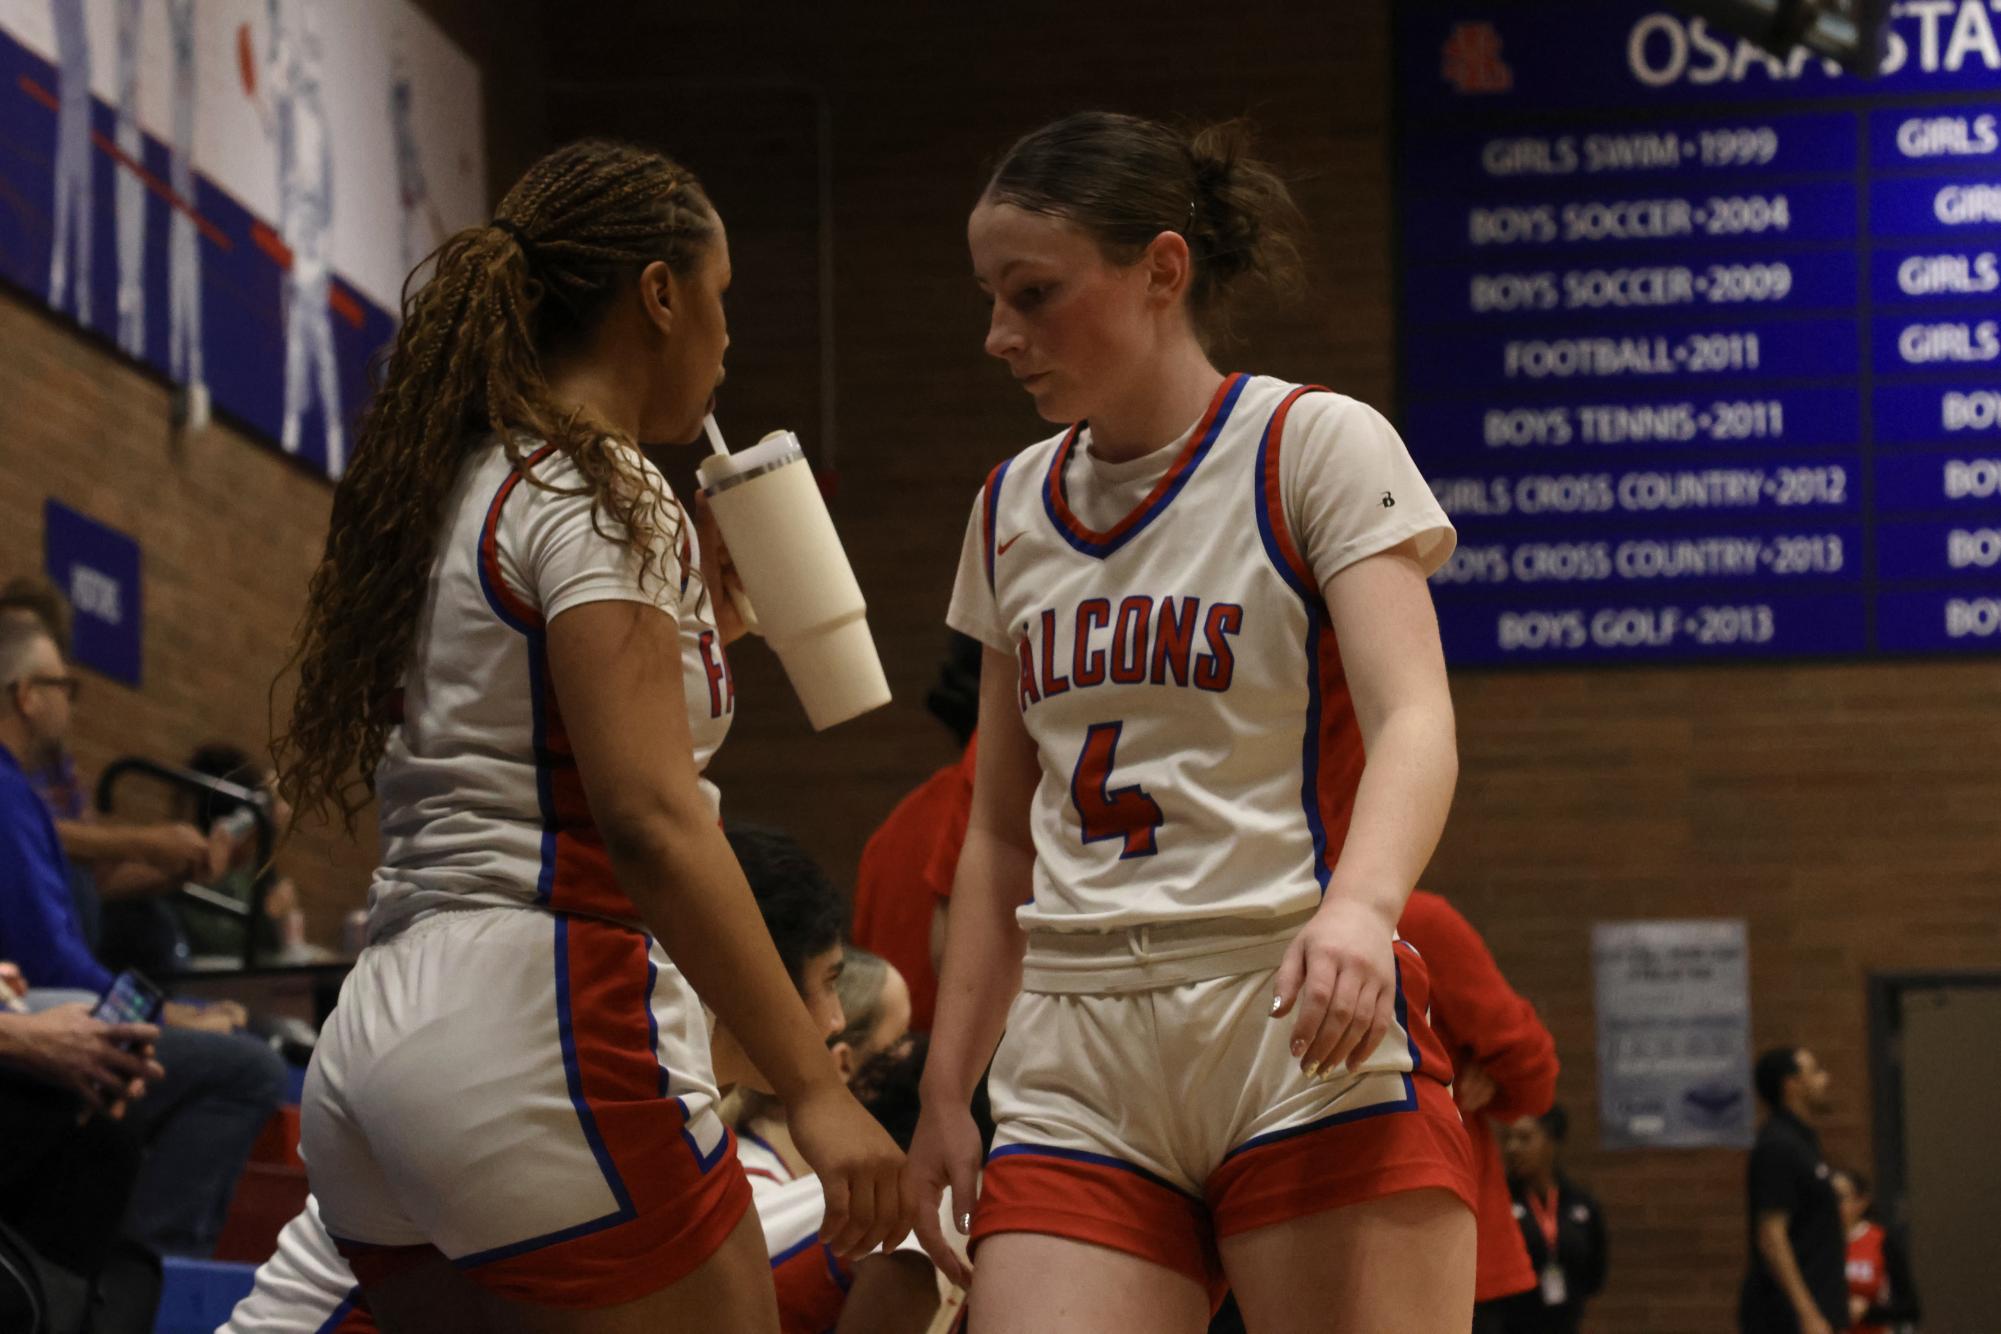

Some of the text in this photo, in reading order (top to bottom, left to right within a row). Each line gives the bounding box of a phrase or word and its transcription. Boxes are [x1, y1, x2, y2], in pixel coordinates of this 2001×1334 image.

[1896, 115, 1998, 157] GIRLS
[1482, 137, 1578, 176] GIRLS
[1470, 205, 1557, 245] BOYS
[1470, 273, 1558, 312] BOYS
[1898, 252, 1999, 295] GIRLS
[1899, 321, 1999, 363] GIRLS
[1484, 406, 1572, 446] BOYS
[1515, 474, 1614, 514] CROSS
[1944, 458, 2001, 498] BO
[1512, 541, 1612, 582] CROSS
[1947, 528, 2001, 568] BO
[1499, 610, 1586, 650] BOYS
[1946, 597, 2001, 638] BO
[1071, 720, 1163, 860] 4
